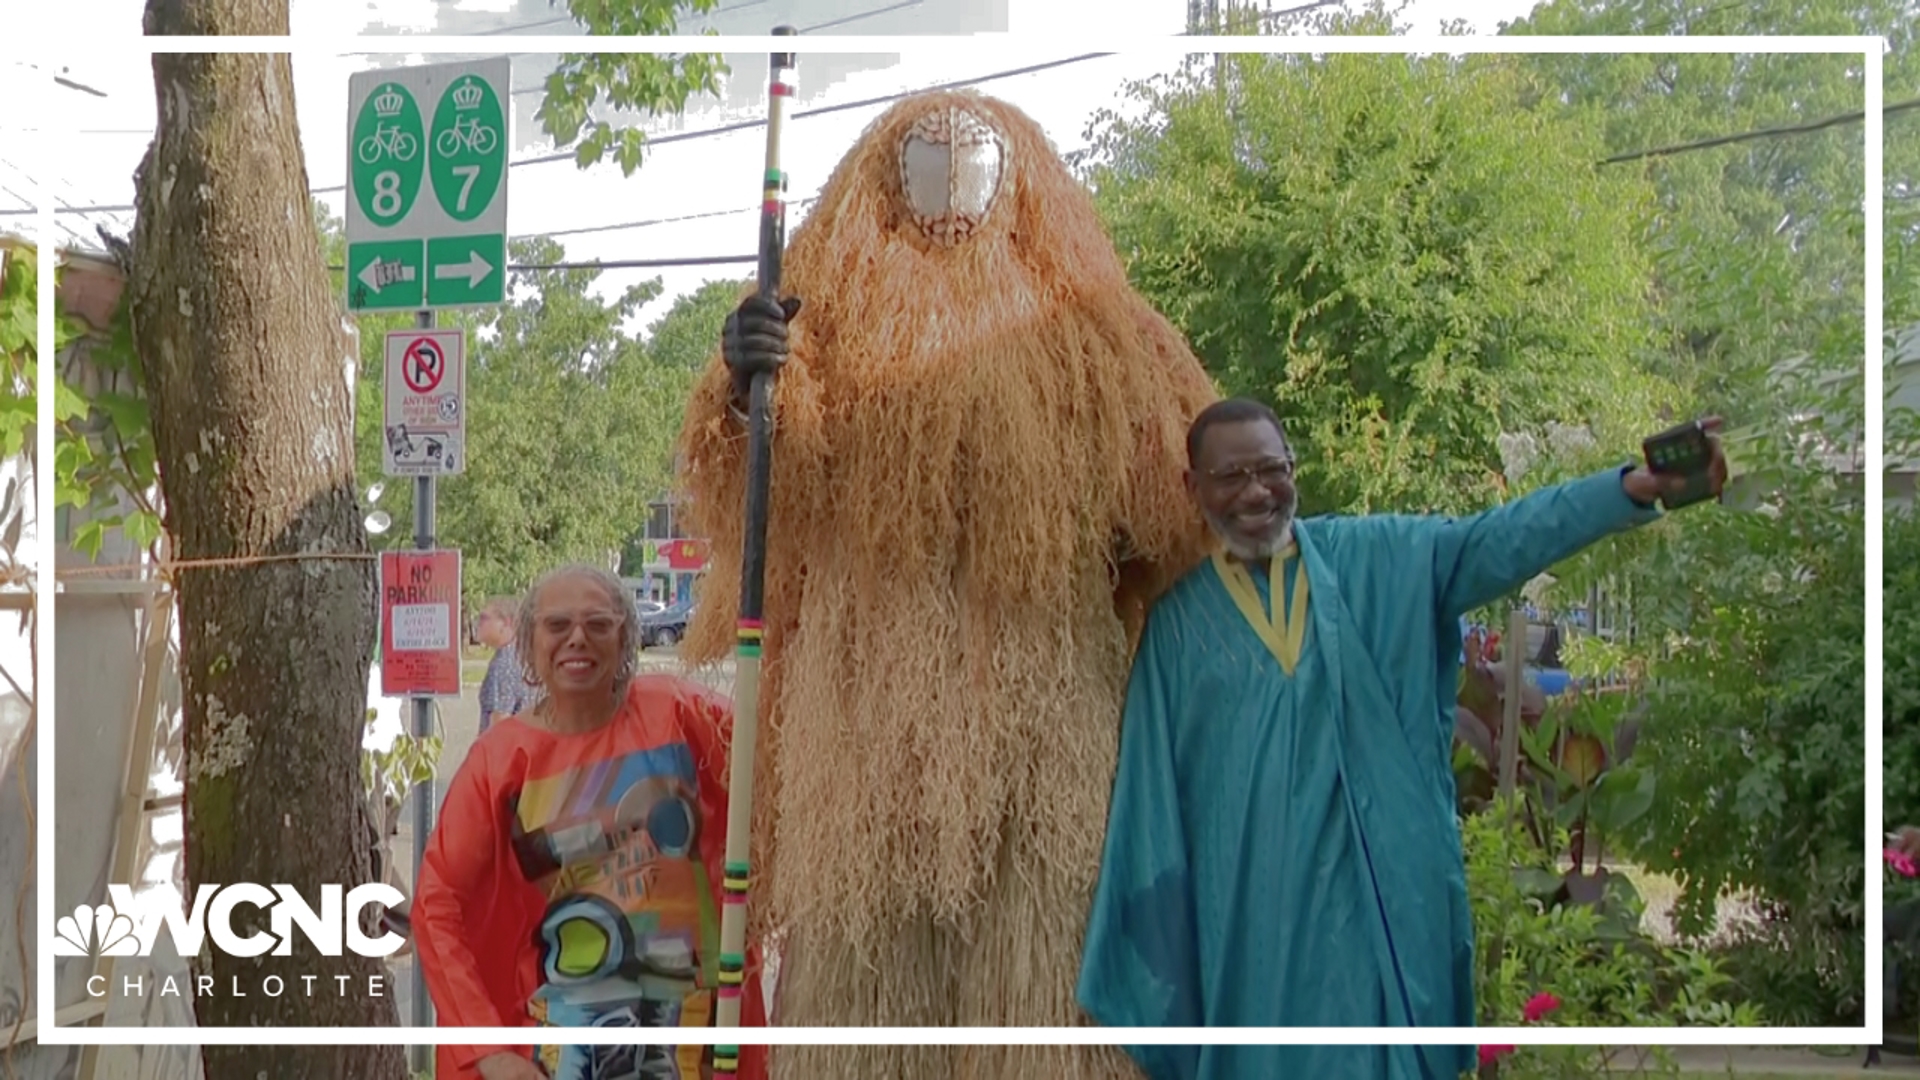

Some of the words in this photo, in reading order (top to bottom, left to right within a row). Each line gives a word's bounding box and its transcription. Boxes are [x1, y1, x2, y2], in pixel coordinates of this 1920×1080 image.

[372, 170, 402, 217] 8
[452, 164, 481, 212] 7
[411, 564, 432, 583] NO
[387, 584, 453, 604] PARKING
